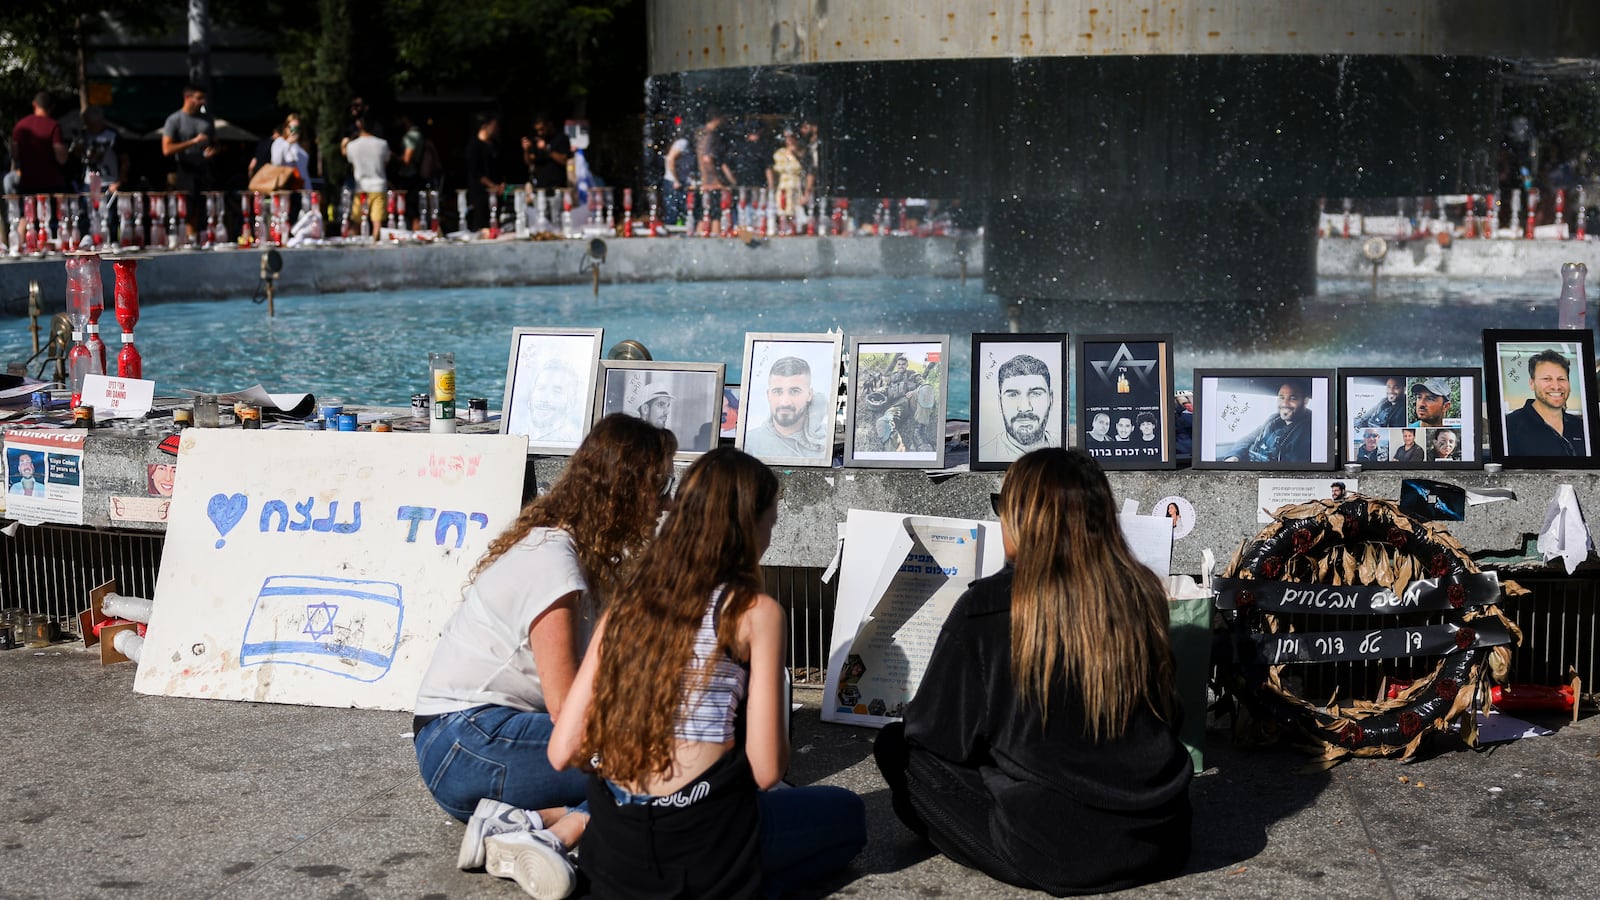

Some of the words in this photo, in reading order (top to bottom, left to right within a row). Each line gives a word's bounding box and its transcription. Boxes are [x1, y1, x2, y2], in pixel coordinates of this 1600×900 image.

[1088, 448, 1112, 458] ברוך
[1115, 447, 1139, 456] זכרם
[1142, 447, 1158, 456] יהי
[259, 496, 361, 534] ננצח
[397, 504, 489, 549] יחד
[906, 554, 933, 563] תפיל
[899, 564, 922, 573] הפצ
[925, 565, 958, 576] לשלום
[1280, 588, 1359, 609] מבטחים
[1370, 588, 1421, 609] משב
[1315, 637, 1344, 655] דור
[1358, 630, 1382, 654] טל
[1405, 631, 1423, 654] דן
